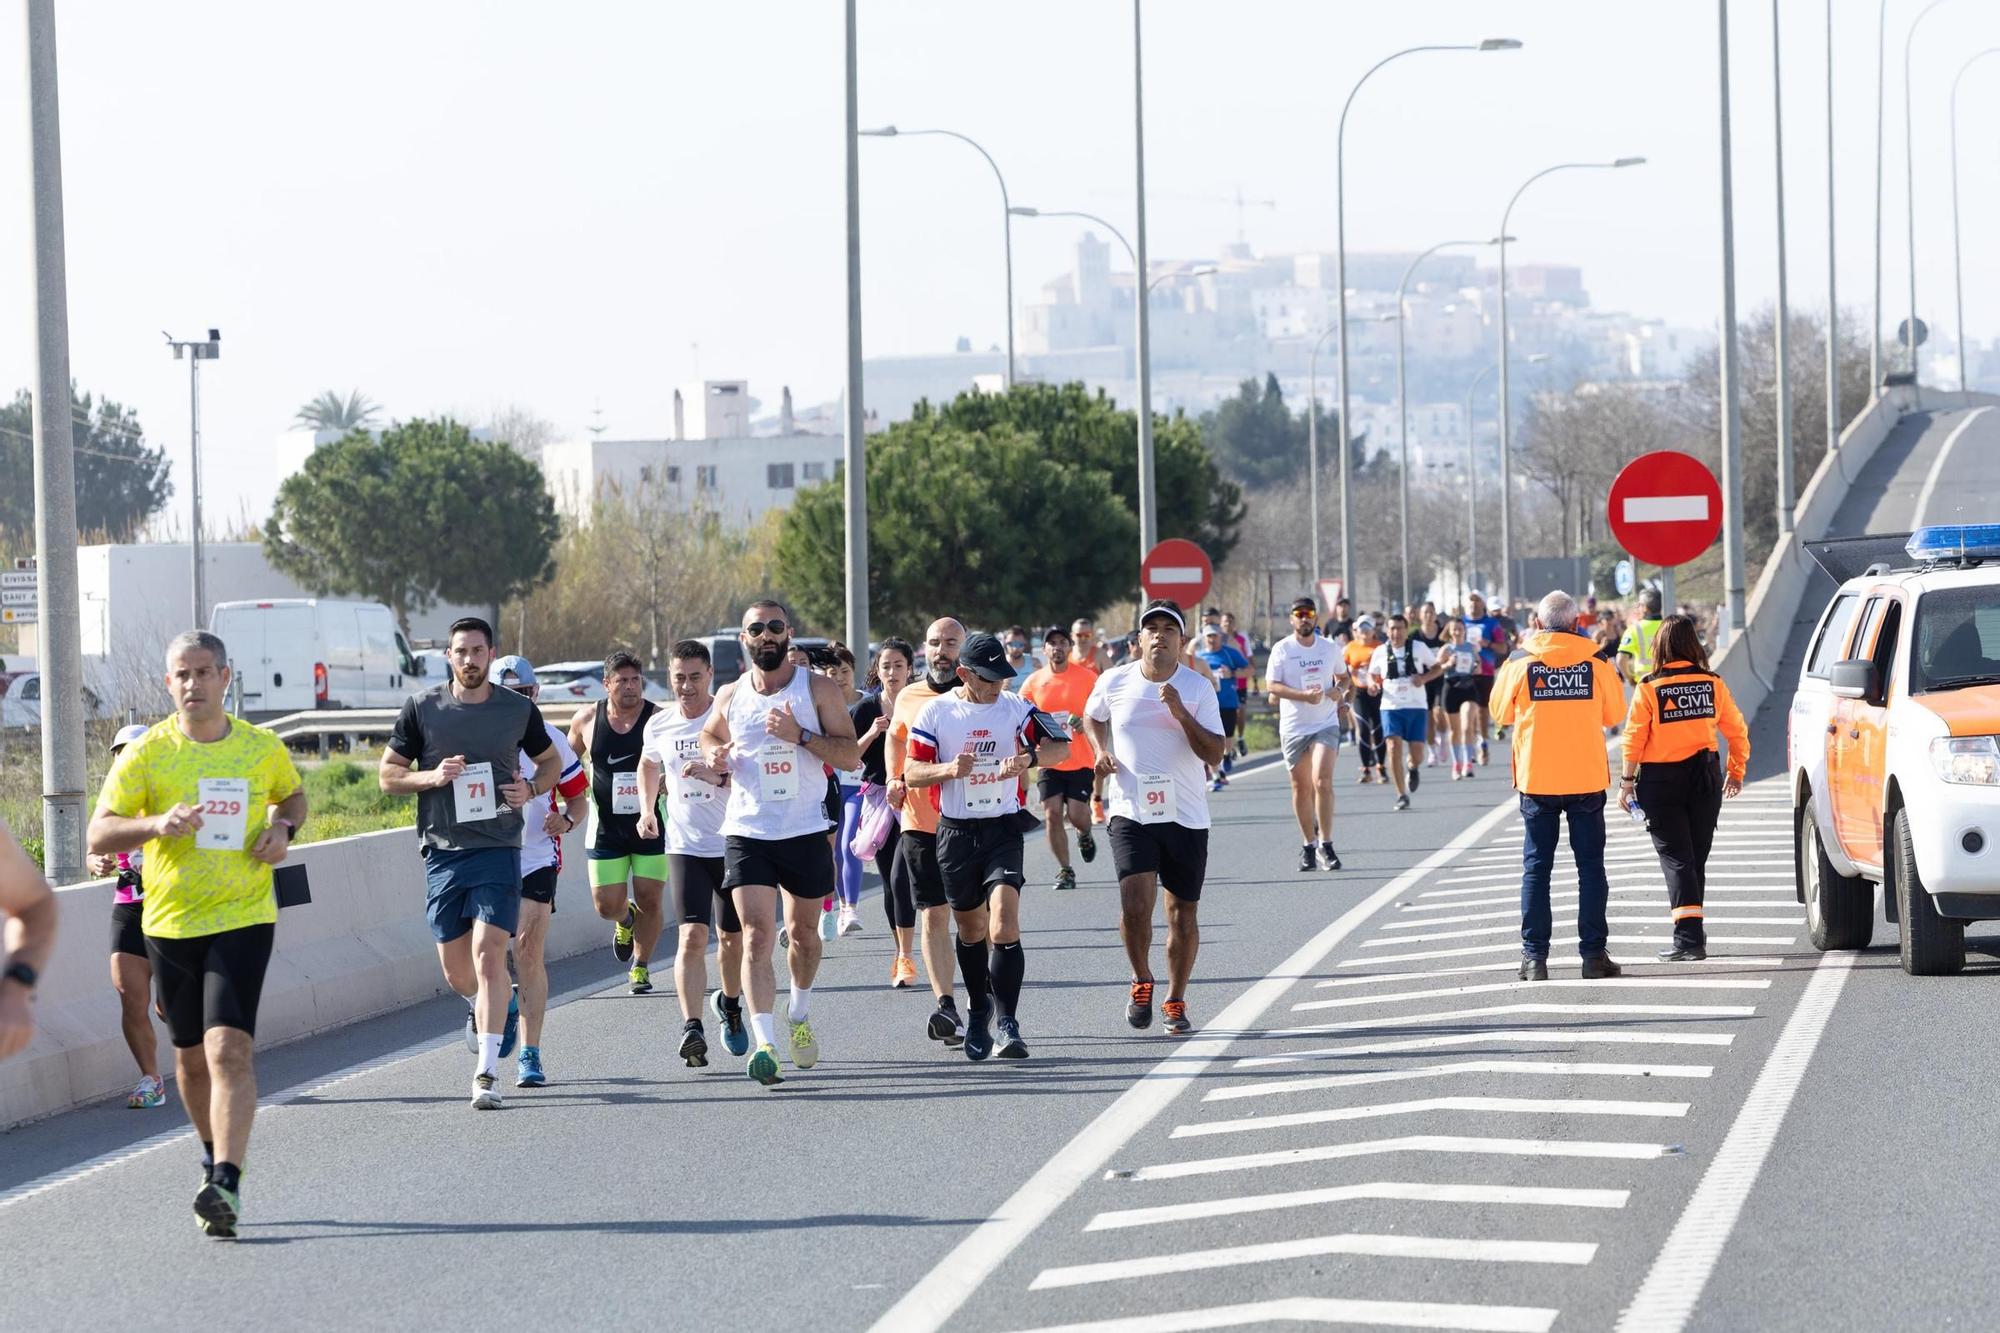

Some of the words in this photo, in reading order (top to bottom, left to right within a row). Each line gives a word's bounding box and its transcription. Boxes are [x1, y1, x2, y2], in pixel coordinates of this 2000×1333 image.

[1299, 659, 1323, 668] U-run
[1532, 663, 1589, 674] PROTECCIÓ
[1547, 674, 1589, 689] CIVIL
[1533, 689, 1554, 697] ILLES
[1554, 688, 1589, 696] BALEARS
[1660, 682, 1712, 697] PROTECCIÓ
[1677, 693, 1714, 709] CIVIL
[1663, 710, 1683, 719] ILLES
[1683, 707, 1714, 717] BALEARS
[763, 761, 792, 775] 150
[969, 772, 997, 786] 324
[466, 782, 486, 799] 71
[616, 785, 639, 796] 248
[1146, 790, 1165, 805] 91
[206, 800, 241, 816] 229
